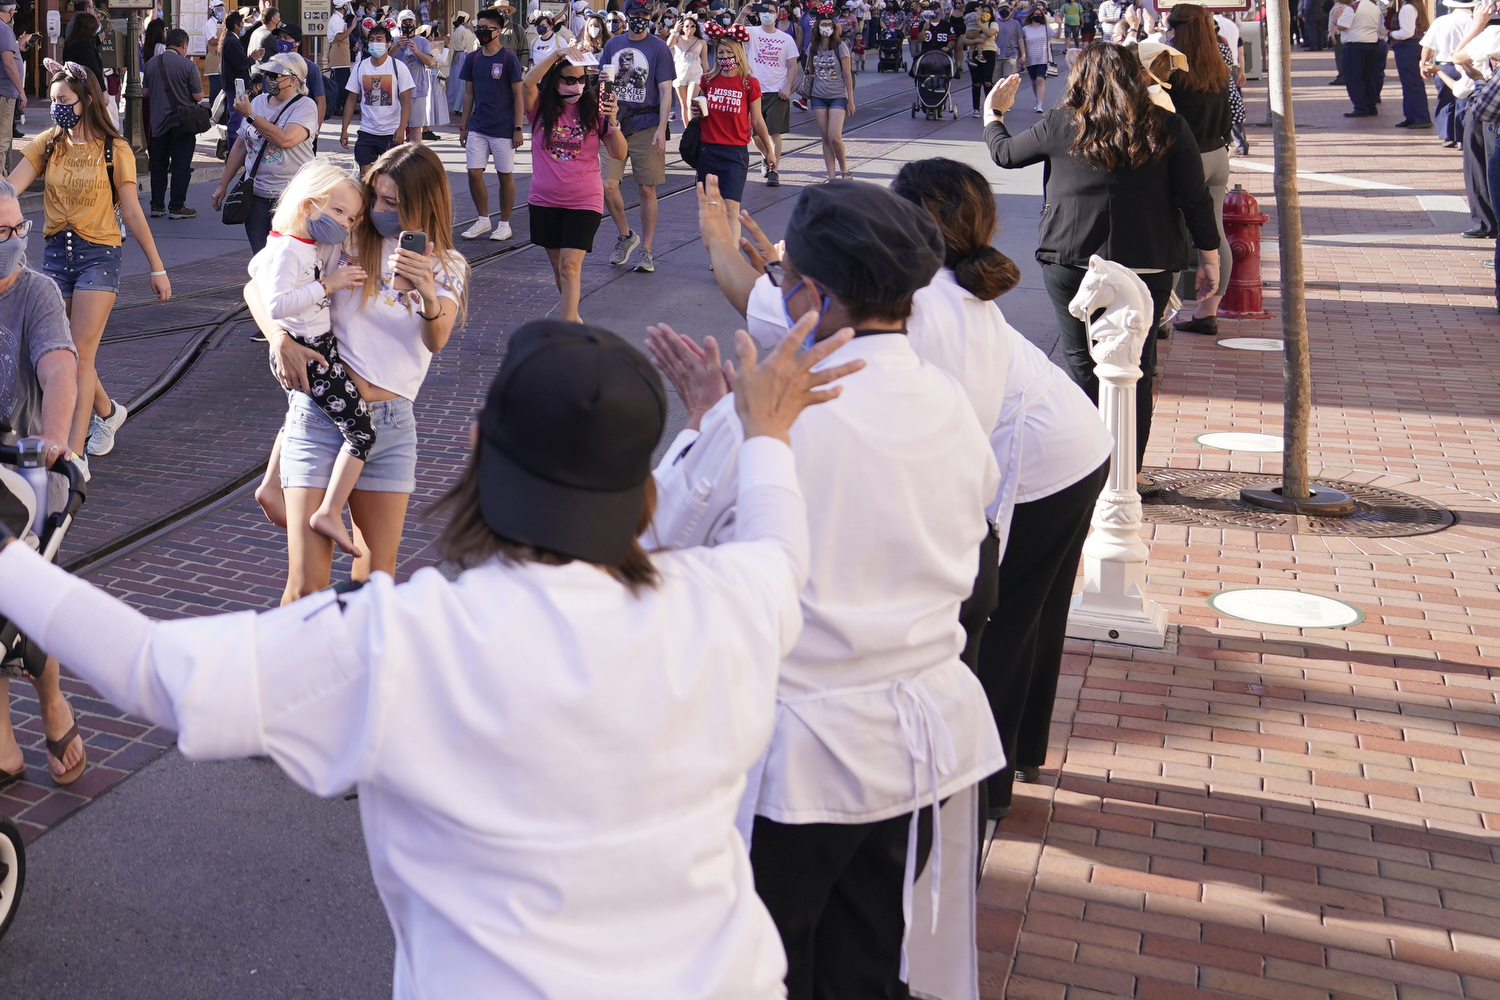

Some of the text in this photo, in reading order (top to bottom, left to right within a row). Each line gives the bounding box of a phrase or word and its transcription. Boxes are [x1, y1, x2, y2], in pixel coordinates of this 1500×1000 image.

[937, 33, 948, 42] 55
[713, 87, 743, 99] MISSED
[725, 96, 742, 106] TOO
